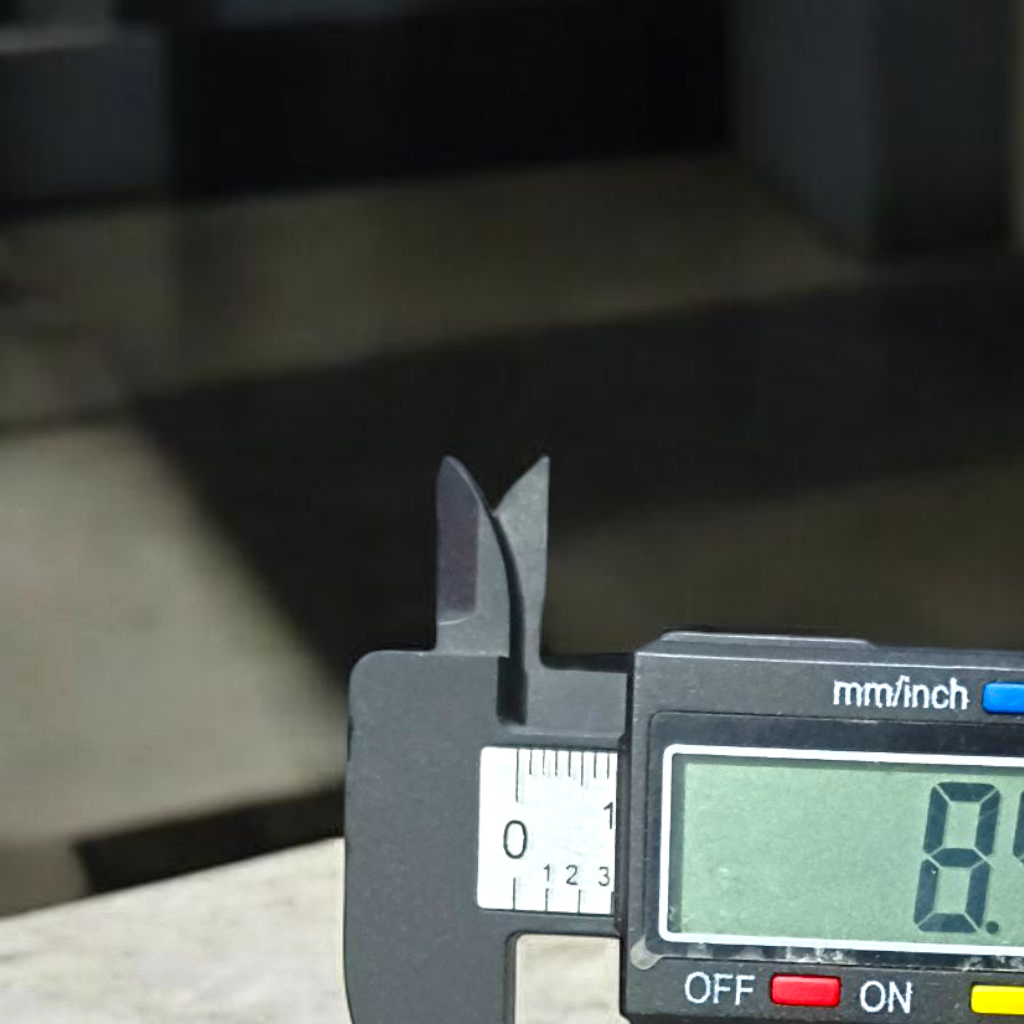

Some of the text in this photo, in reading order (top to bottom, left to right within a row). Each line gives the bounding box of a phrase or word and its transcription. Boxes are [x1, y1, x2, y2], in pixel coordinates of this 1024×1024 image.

[832, 675, 969, 711] mm/inch
[503, 819, 528, 860] 0
[543, 863, 611, 887] 1 2 3
[683, 971, 756, 1005] OFF
[859, 979, 914, 1014] ON
